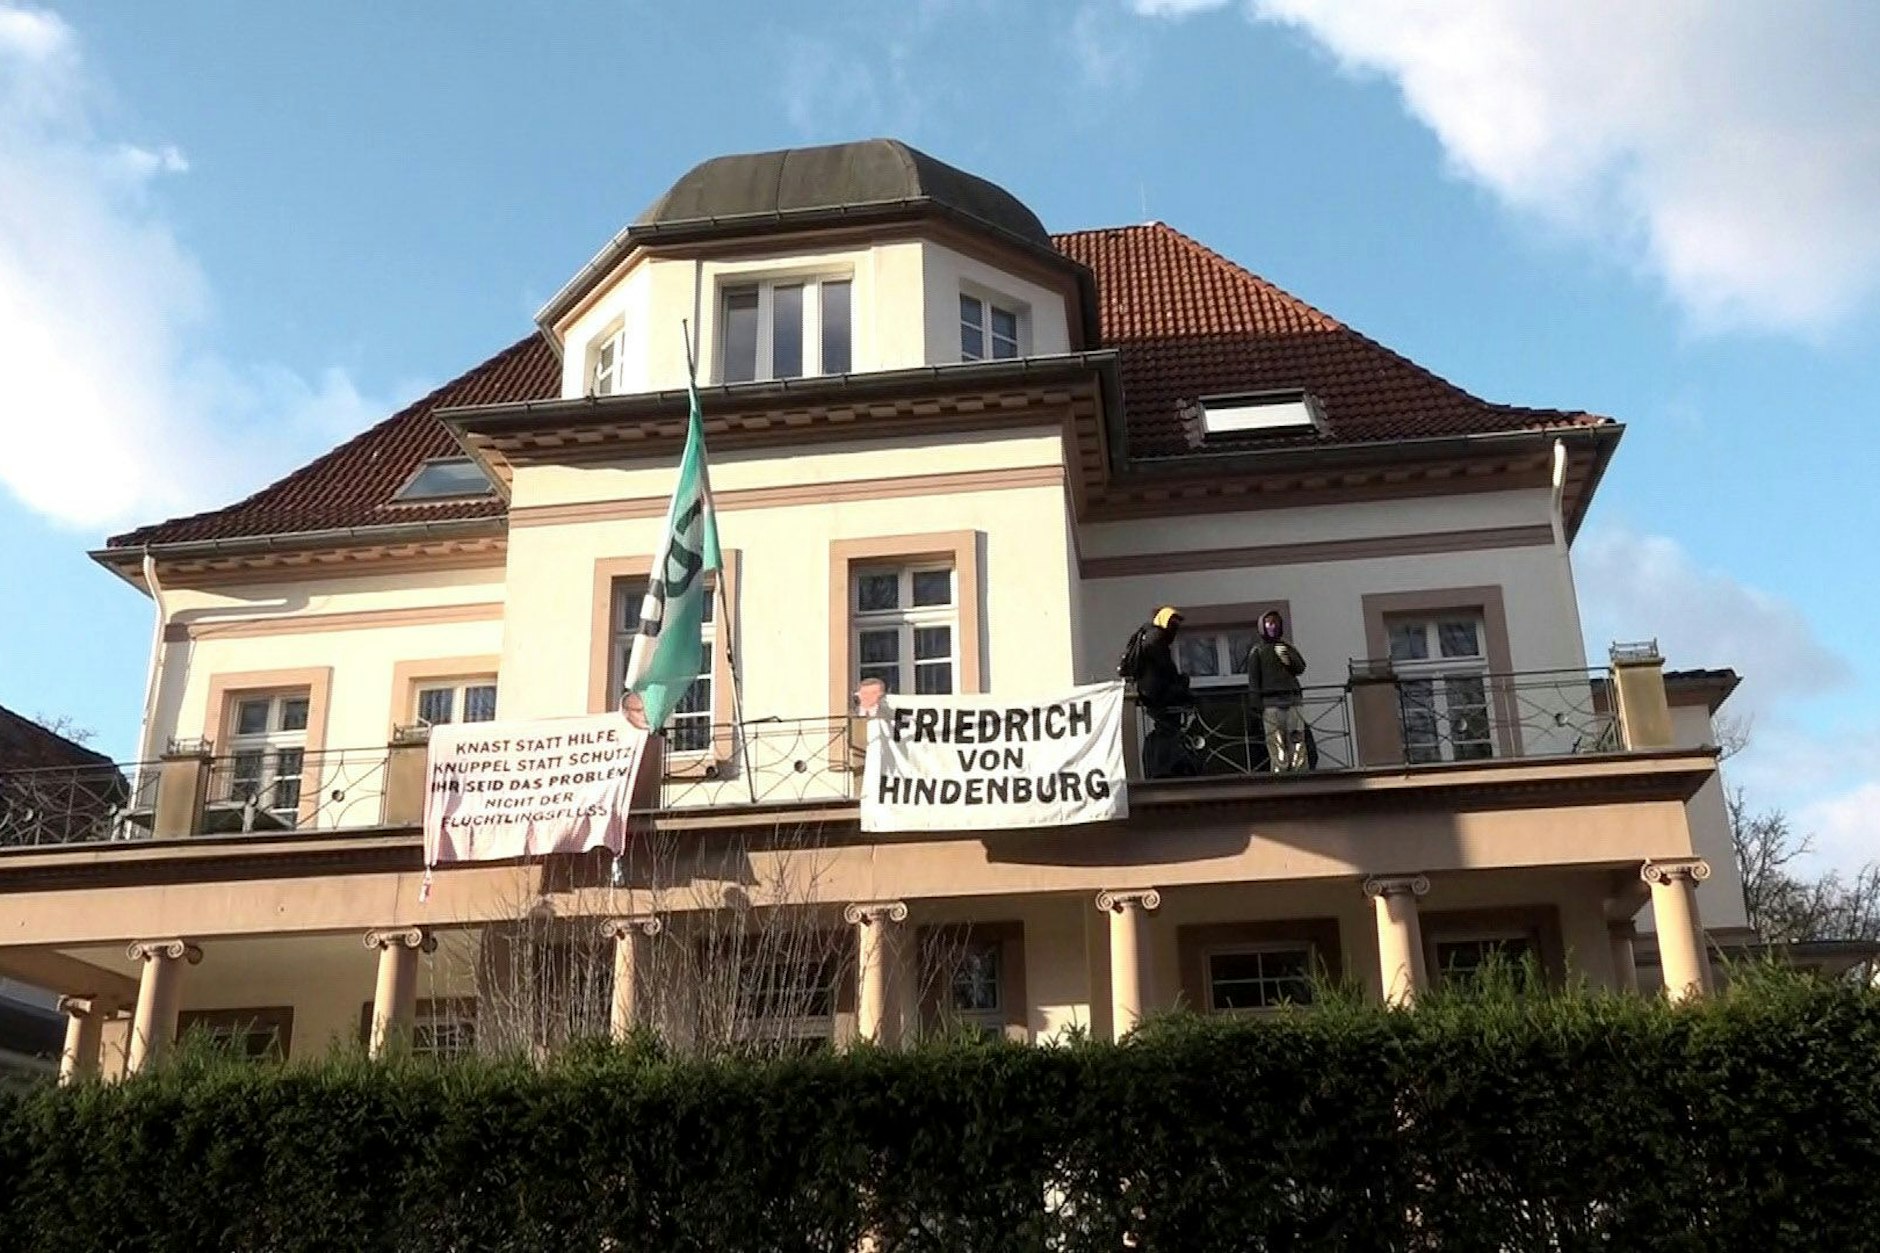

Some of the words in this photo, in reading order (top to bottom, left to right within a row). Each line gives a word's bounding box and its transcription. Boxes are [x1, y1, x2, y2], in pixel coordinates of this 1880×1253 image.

[892, 700, 1093, 744] FRIEDRICH
[456, 739, 511, 755] KNAST
[516, 736, 563, 752] STATT
[517, 756, 563, 772] STATT
[957, 748, 1024, 772] VON
[431, 780, 459, 793] IHR
[466, 779, 504, 793] SEID
[510, 777, 543, 791] DAS
[878, 768, 1111, 806] HINDENBURG
[485, 796, 535, 809] NICHT
[540, 792, 574, 806] DER
